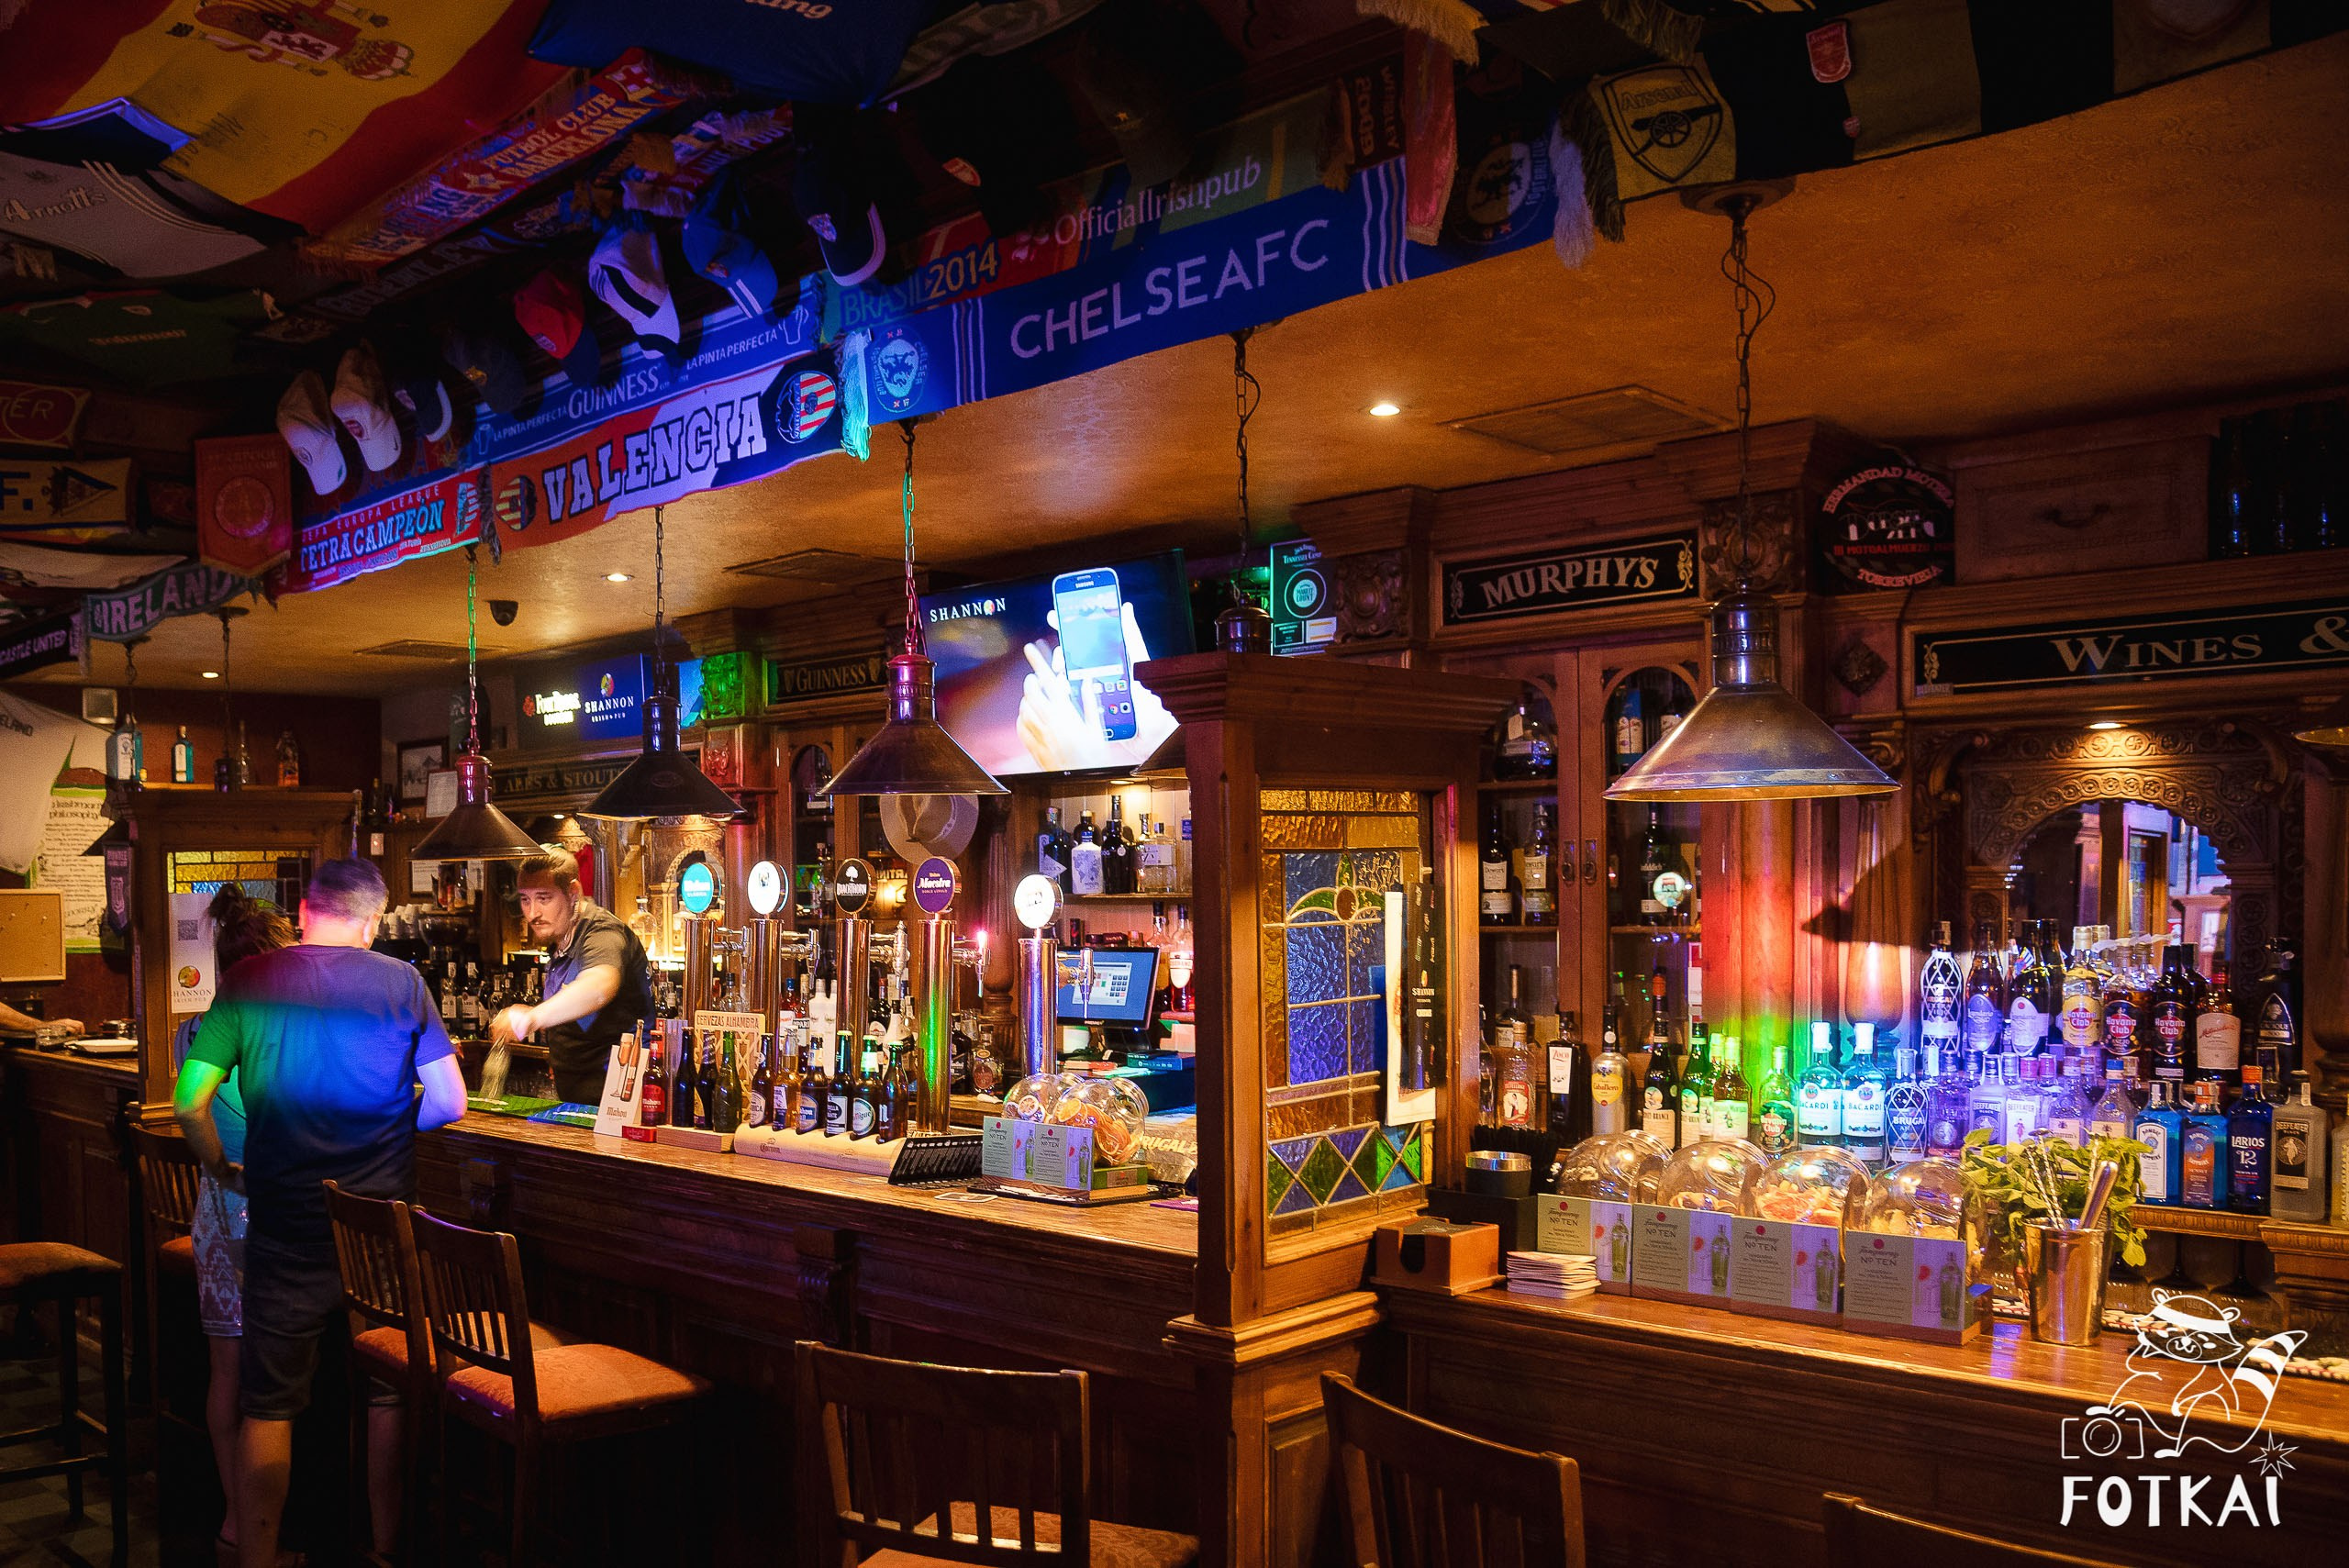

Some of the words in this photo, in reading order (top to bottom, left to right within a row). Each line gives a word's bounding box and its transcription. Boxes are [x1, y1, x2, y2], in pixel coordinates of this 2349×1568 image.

[556, 93, 617, 131] CLUB
[928, 243, 998, 300] 2014
[568, 366, 659, 419] GUINNESS
[541, 391, 769, 523] VALENCIA
[1822, 466, 1904, 515] HERMANDAD
[391, 485, 440, 511] LEAGUE
[1479, 556, 1659, 609] MURPHY'S
[100, 567, 232, 635] IRELAND
[33, 628, 67, 653] UNITED
[2299, 617, 2349, 654] &
[796, 661, 866, 690] GUINNESS
[584, 695, 634, 714] SHANNON
[696, 1014, 725, 1028] CERVEZAS
[726, 1015, 760, 1029] ALHAMBRA
[2071, 1018, 2091, 1027] Club
[2106, 1017, 2137, 1027] Havana
[2154, 1018, 2186, 1028] Havana
[2110, 1026, 2131, 1035] Club
[2160, 1027, 2179, 1036] Club
[2165, 1043, 2174, 1052] 7
[607, 1106, 628, 1118] Mahou
[1892, 1116, 1925, 1125] BRUGA
[2276, 1121, 2309, 1133] BEEFEATER
[2231, 1135, 2266, 1149] LARIOS
[2235, 1150, 2257, 1166] 12
[1561, 1218, 1578, 1227] TEN
[1658, 1229, 1676, 1238] TEN
[1757, 1242, 1777, 1252] TEN
[1875, 1257, 1898, 1267] TEN
